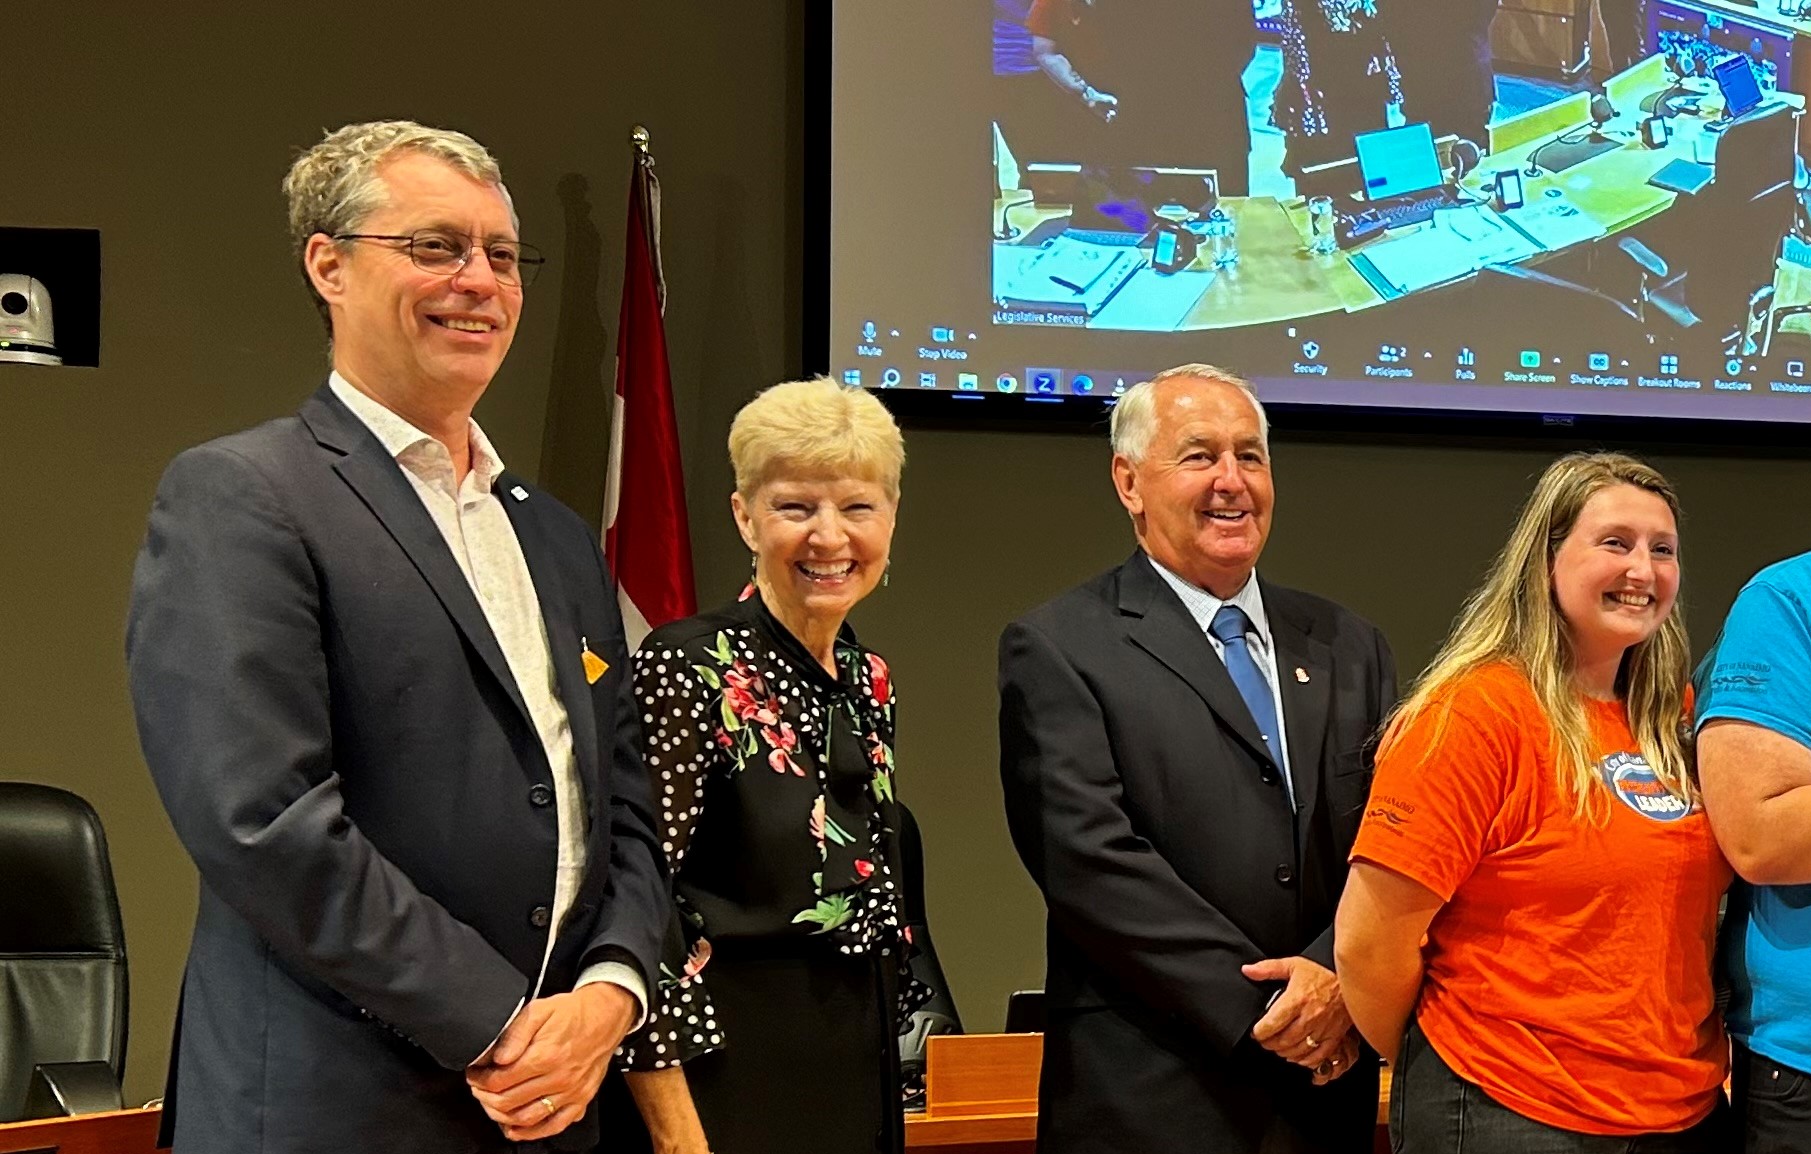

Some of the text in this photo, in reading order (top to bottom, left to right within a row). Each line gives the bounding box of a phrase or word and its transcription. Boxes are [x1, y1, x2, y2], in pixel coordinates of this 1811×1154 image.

[996, 311, 1085, 325] Legislative Services
[858, 345, 882, 357] Mute
[918, 347, 968, 361] Stop Video
[1293, 362, 1328, 376] Security
[1365, 365, 1413, 378] Participants
[1455, 368, 1476, 381] Polls
[1503, 371, 1556, 383] Share Screen
[1570, 373, 1629, 387] Show Captions
[1714, 379, 1752, 391] Reactions
